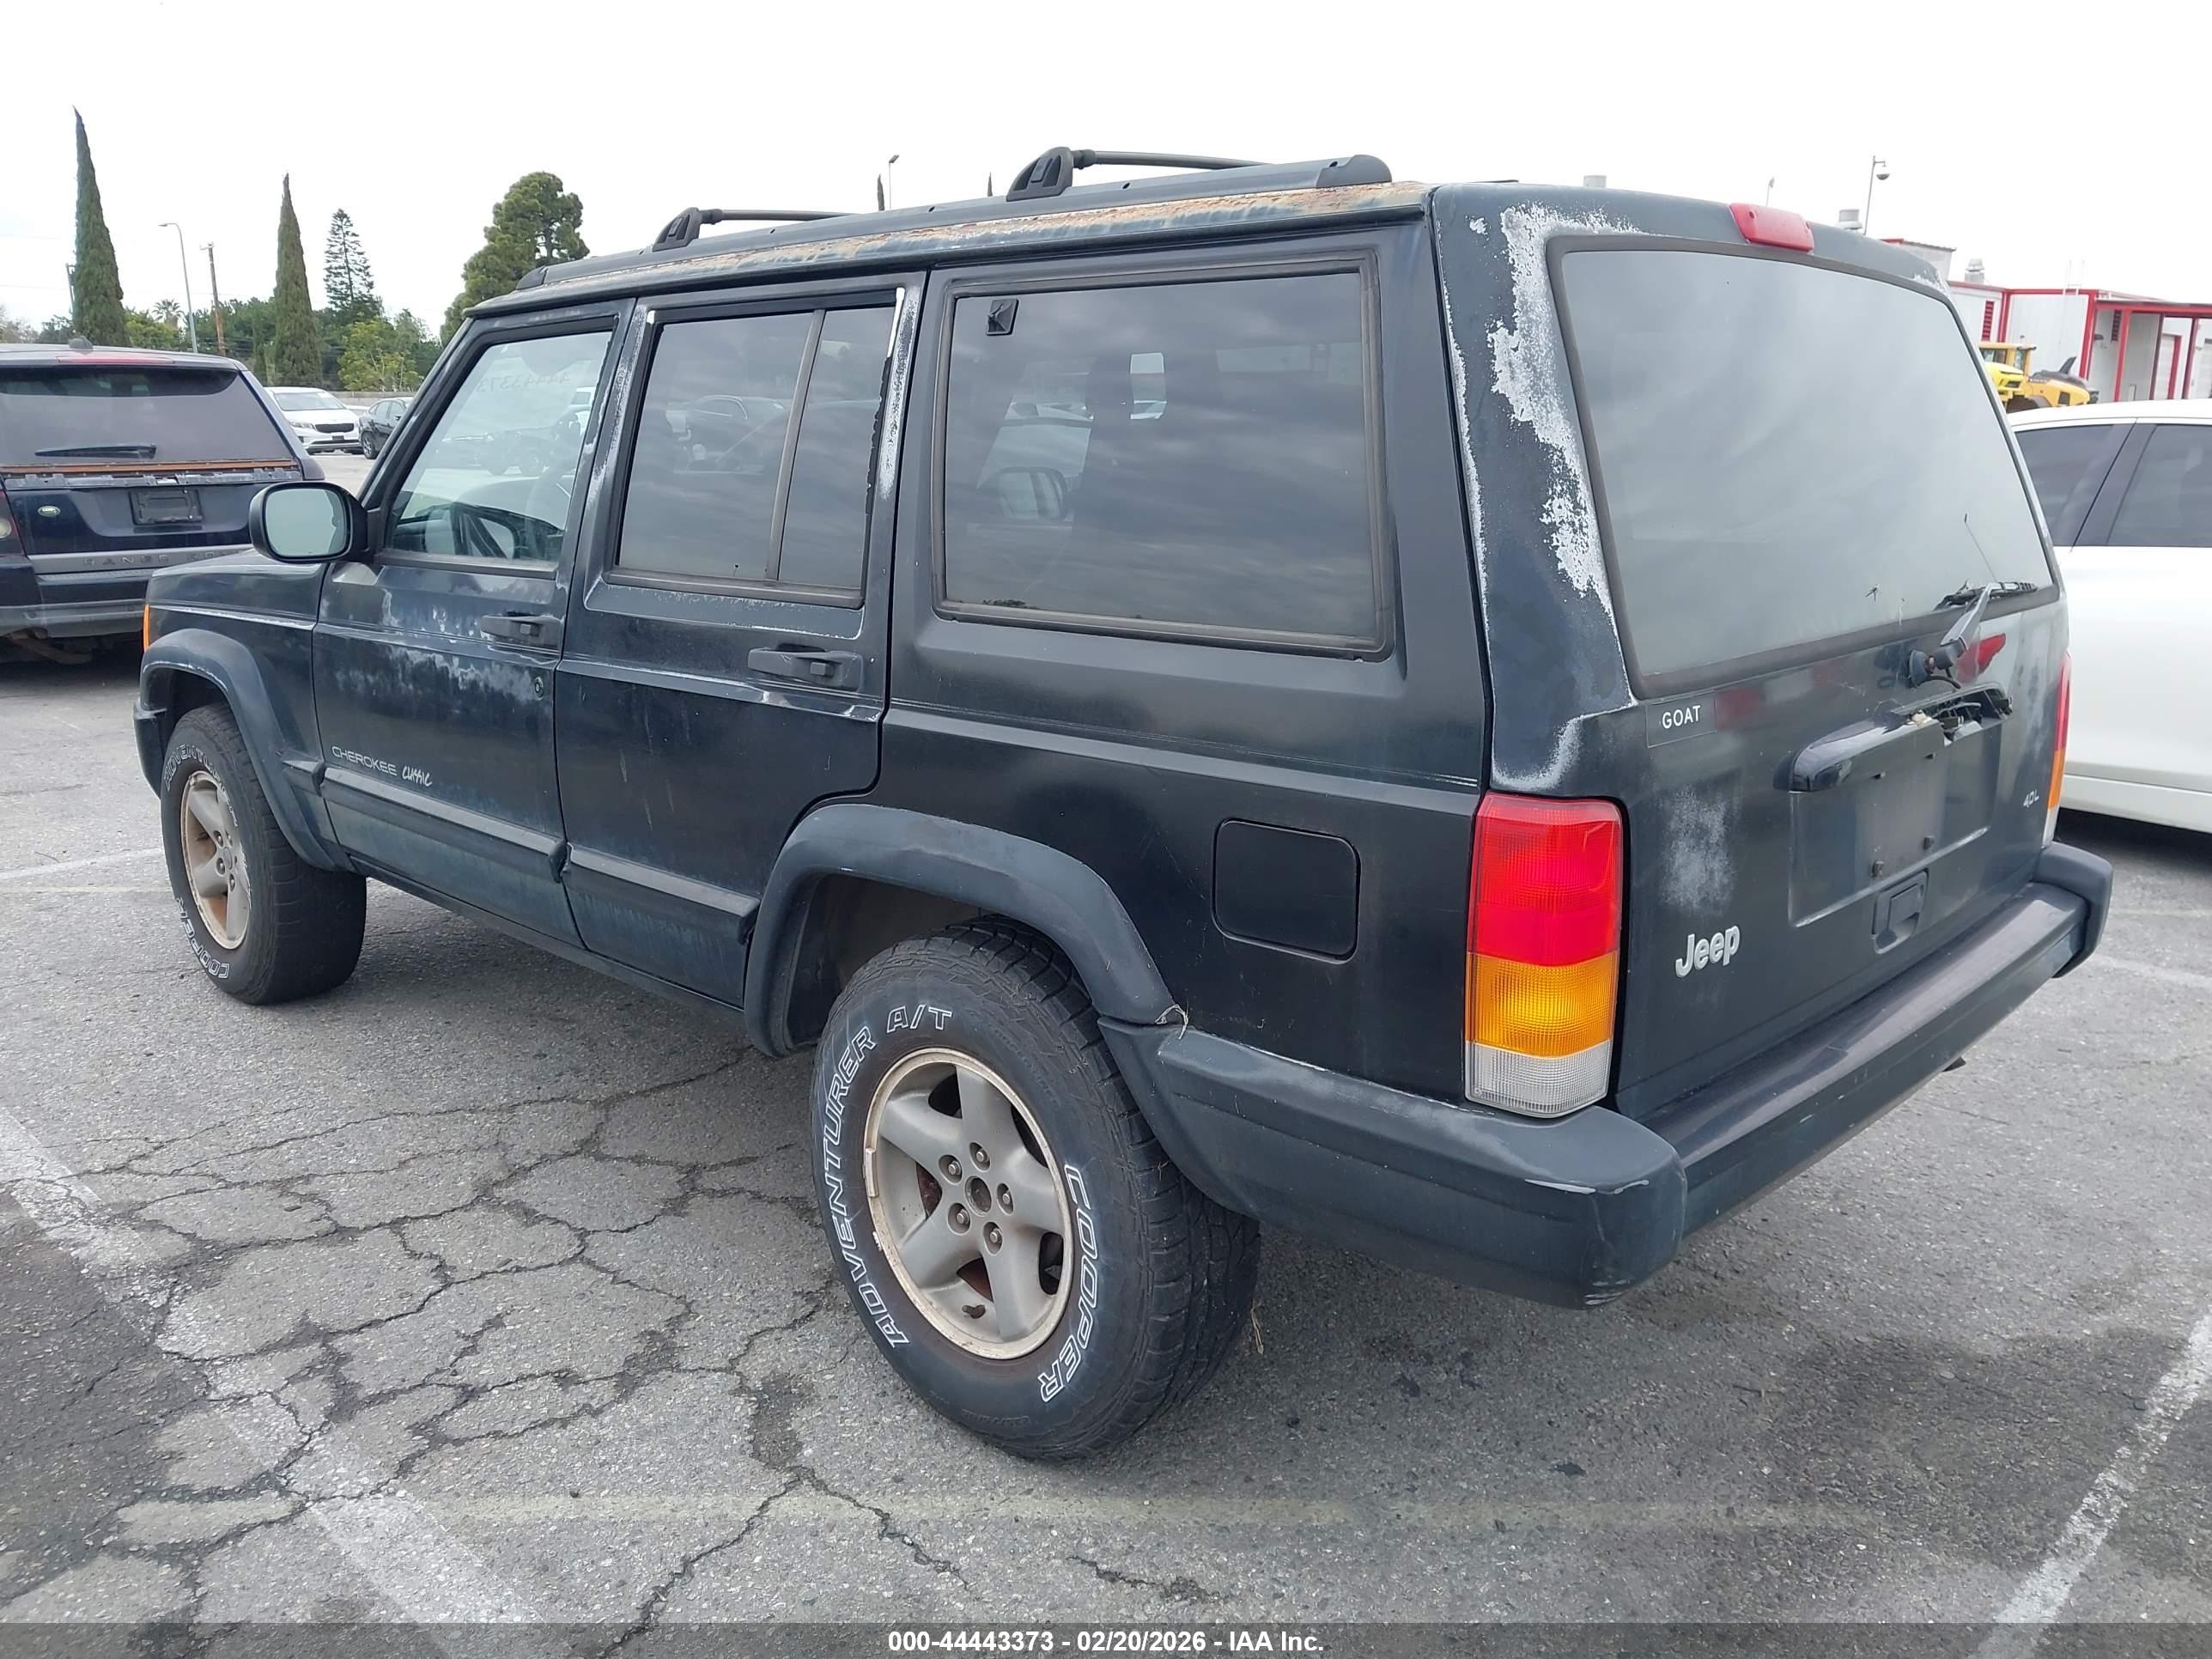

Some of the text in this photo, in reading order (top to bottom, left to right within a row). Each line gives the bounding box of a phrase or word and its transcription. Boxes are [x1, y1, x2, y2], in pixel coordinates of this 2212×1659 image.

[1662, 705, 1701, 729] GOAT
[331, 745, 398, 776] CHEROKEE
[1675, 925, 1741, 978] Jeep
[823, 1004, 953, 1349] ADVENTURER A/T
[1037, 1164, 1098, 1403] COOPER
